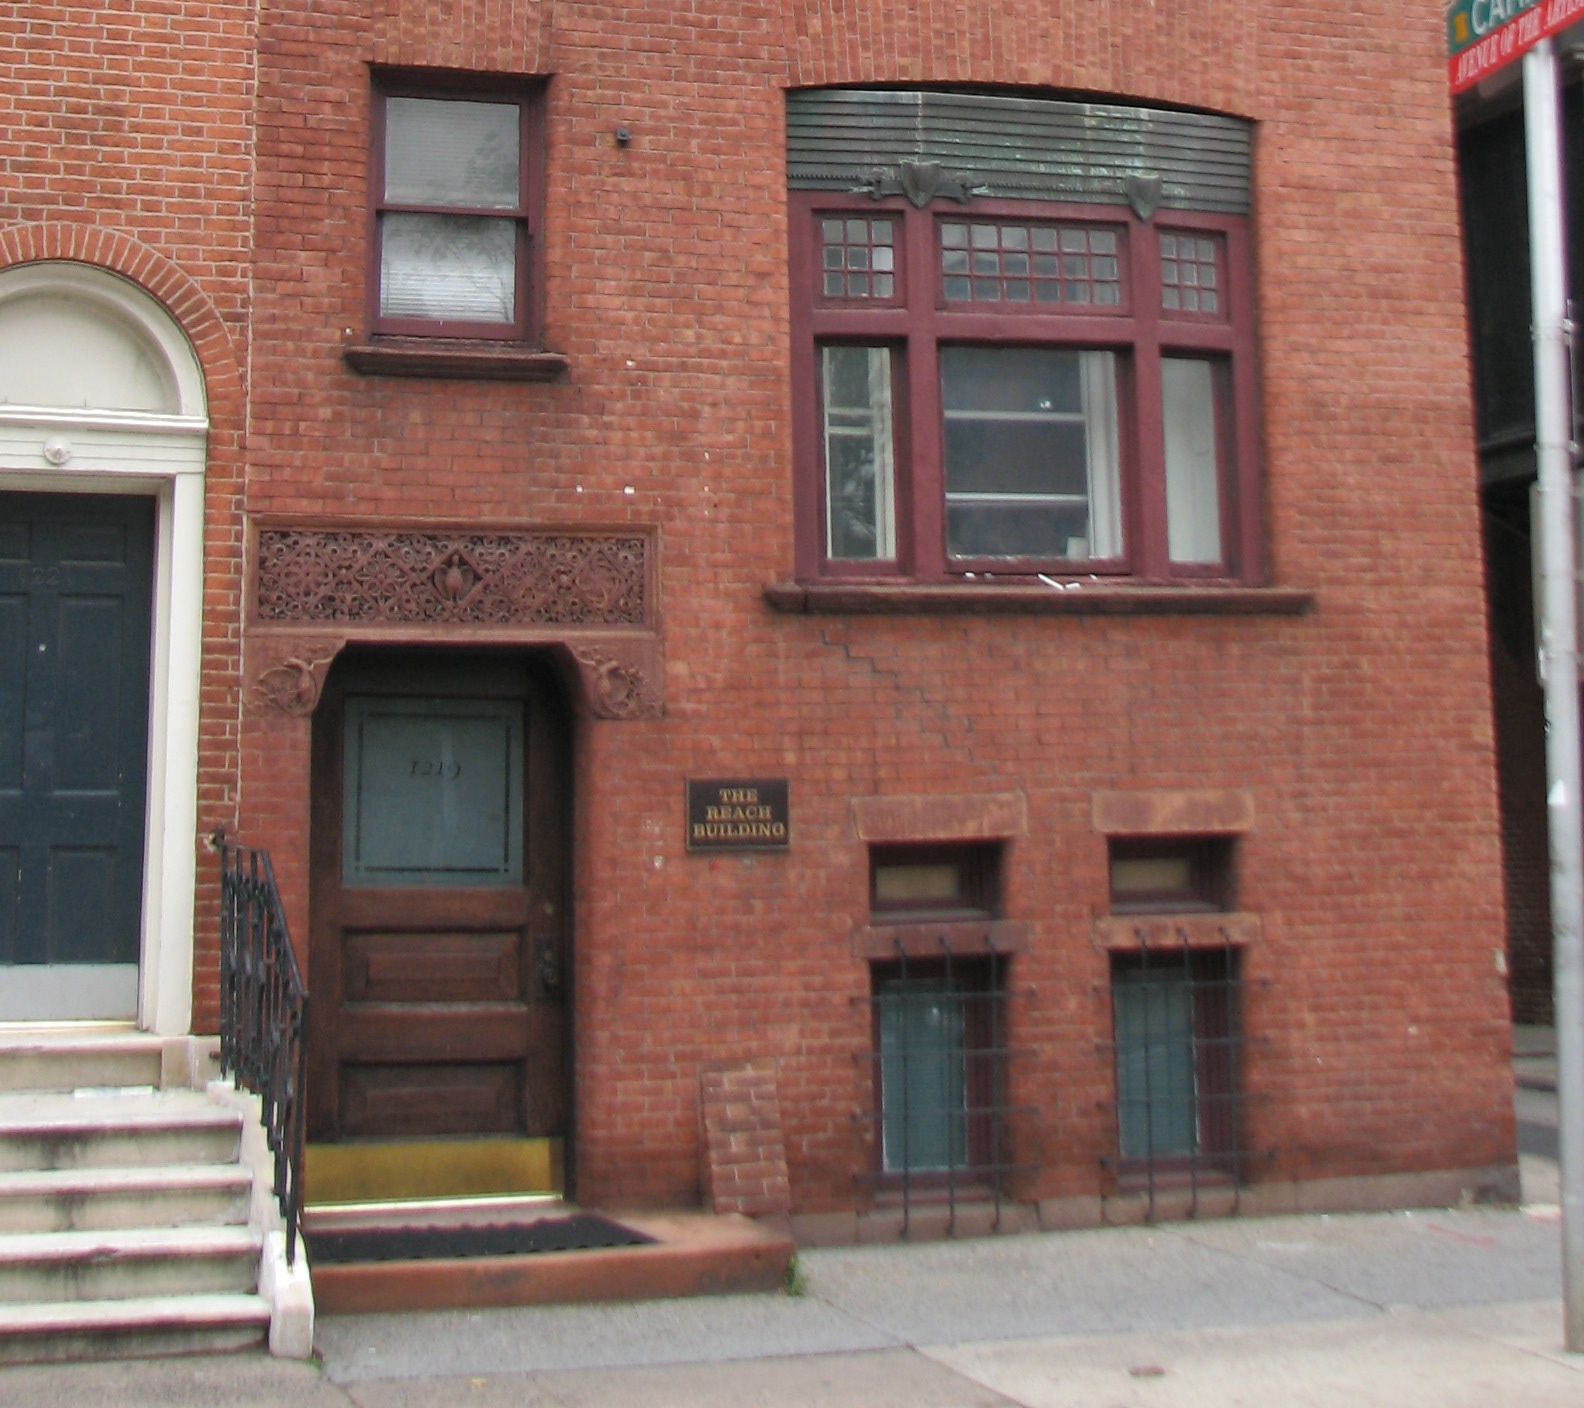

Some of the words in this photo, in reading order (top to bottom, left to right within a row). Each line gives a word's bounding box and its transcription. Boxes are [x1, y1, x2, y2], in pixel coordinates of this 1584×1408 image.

[1455, 33, 1498, 86] AVENUE
[1499, 21, 1517, 57] OF
[1517, 6, 1542, 46] THE
[719, 788, 758, 803] THE
[706, 805, 772, 820] REACH
[693, 823, 785, 838] BUILDING
